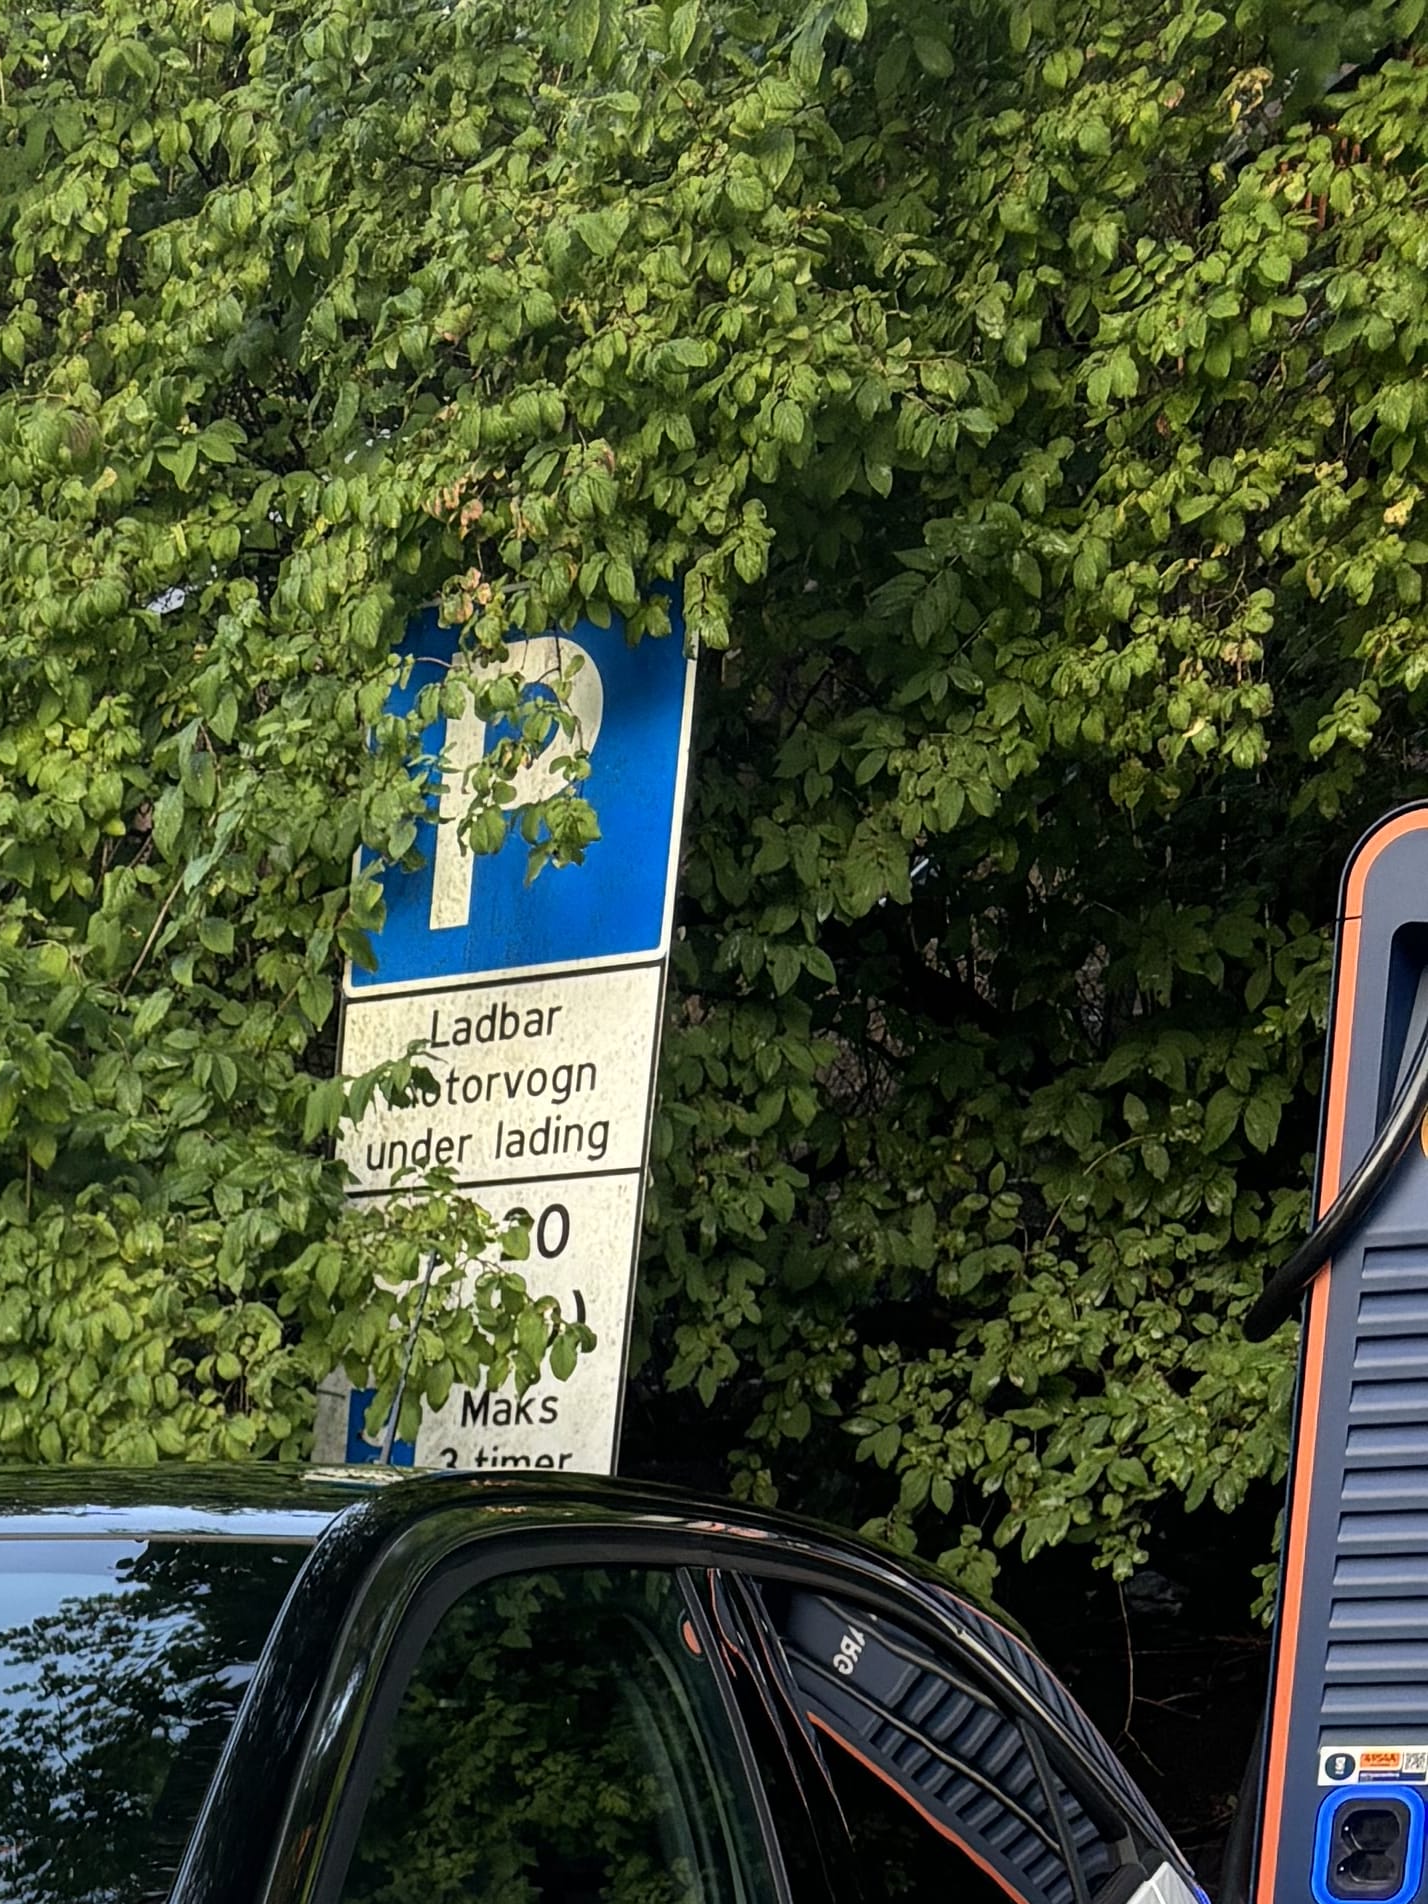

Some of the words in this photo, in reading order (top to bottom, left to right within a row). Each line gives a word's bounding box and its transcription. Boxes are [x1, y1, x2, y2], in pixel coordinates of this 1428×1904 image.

[430, 634, 604, 931] P
[430, 1001, 563, 1048] Ladbar
[387, 1062, 597, 1112] otorvogn
[366, 1128, 473, 1171] under
[495, 1114, 610, 1162] lading
[461, 1390, 559, 1427] Maks
[474, 1445, 574, 1469] timer
